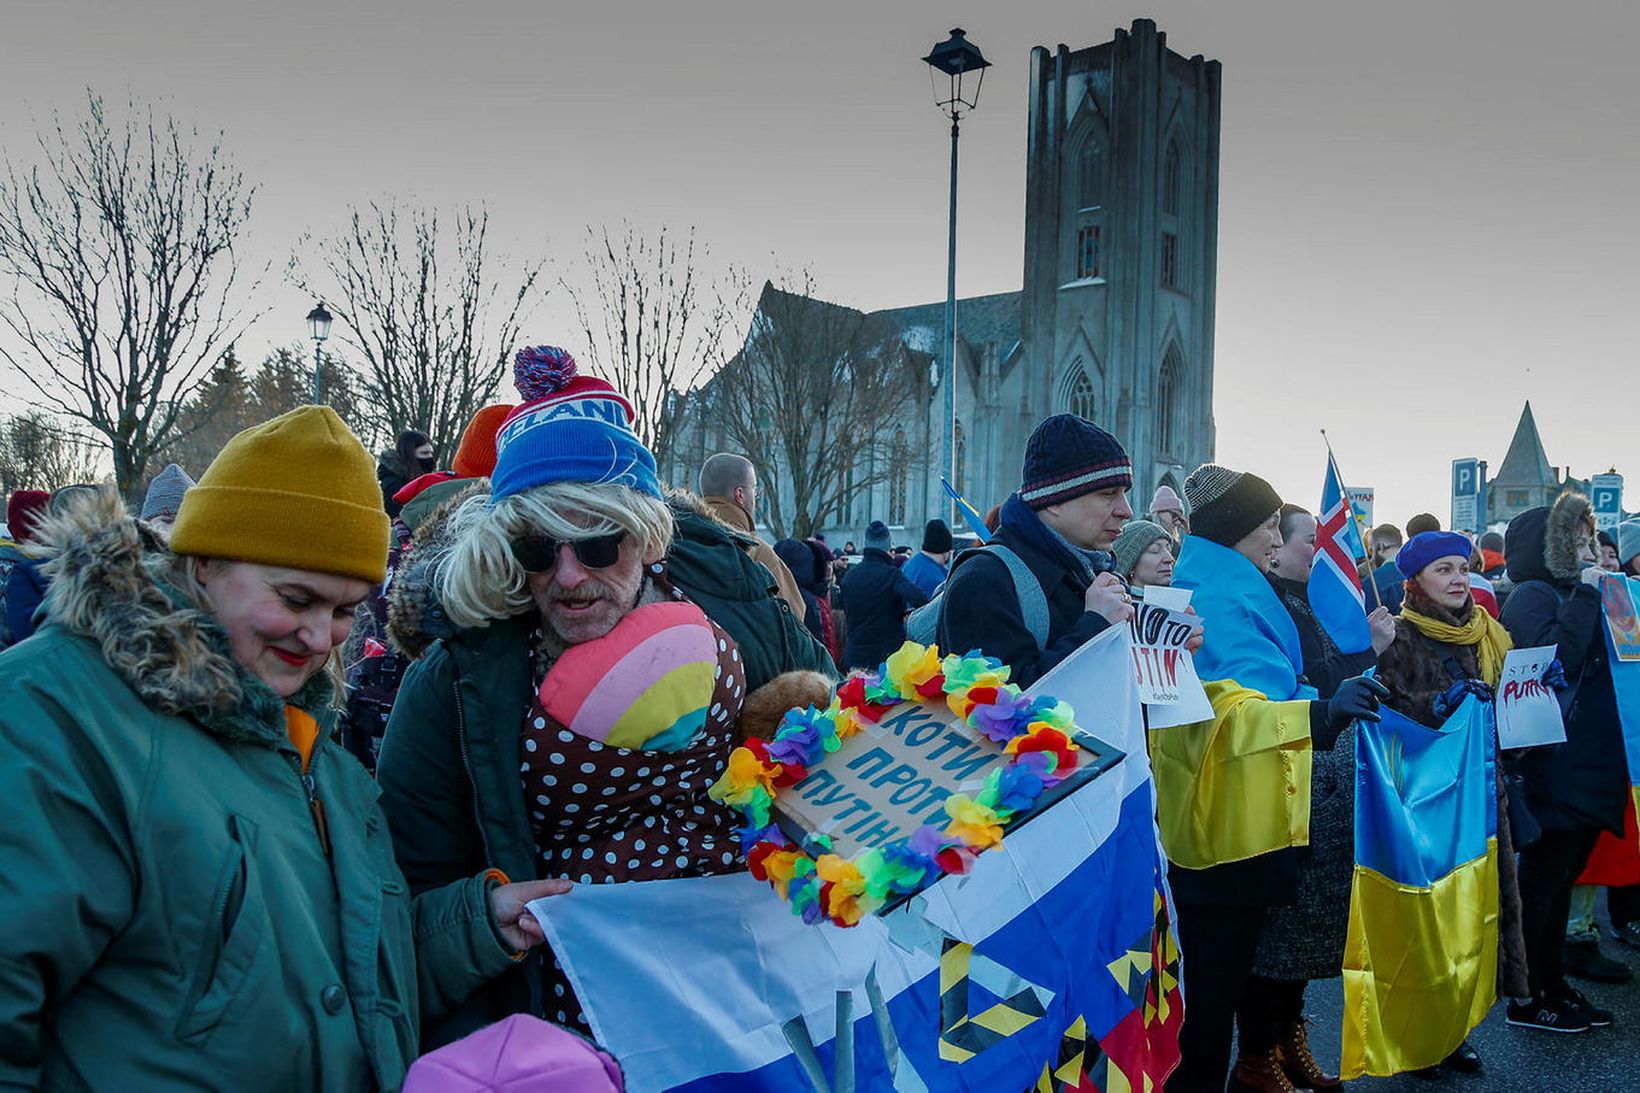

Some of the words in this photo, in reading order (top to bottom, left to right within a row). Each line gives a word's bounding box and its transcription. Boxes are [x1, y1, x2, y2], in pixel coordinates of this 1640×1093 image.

[1460, 468, 1470, 491] P
[1600, 492, 1612, 508] P
[1131, 602, 1169, 645] NO
[1163, 620, 1192, 646] TO
[880, 705, 999, 781] КОТИ
